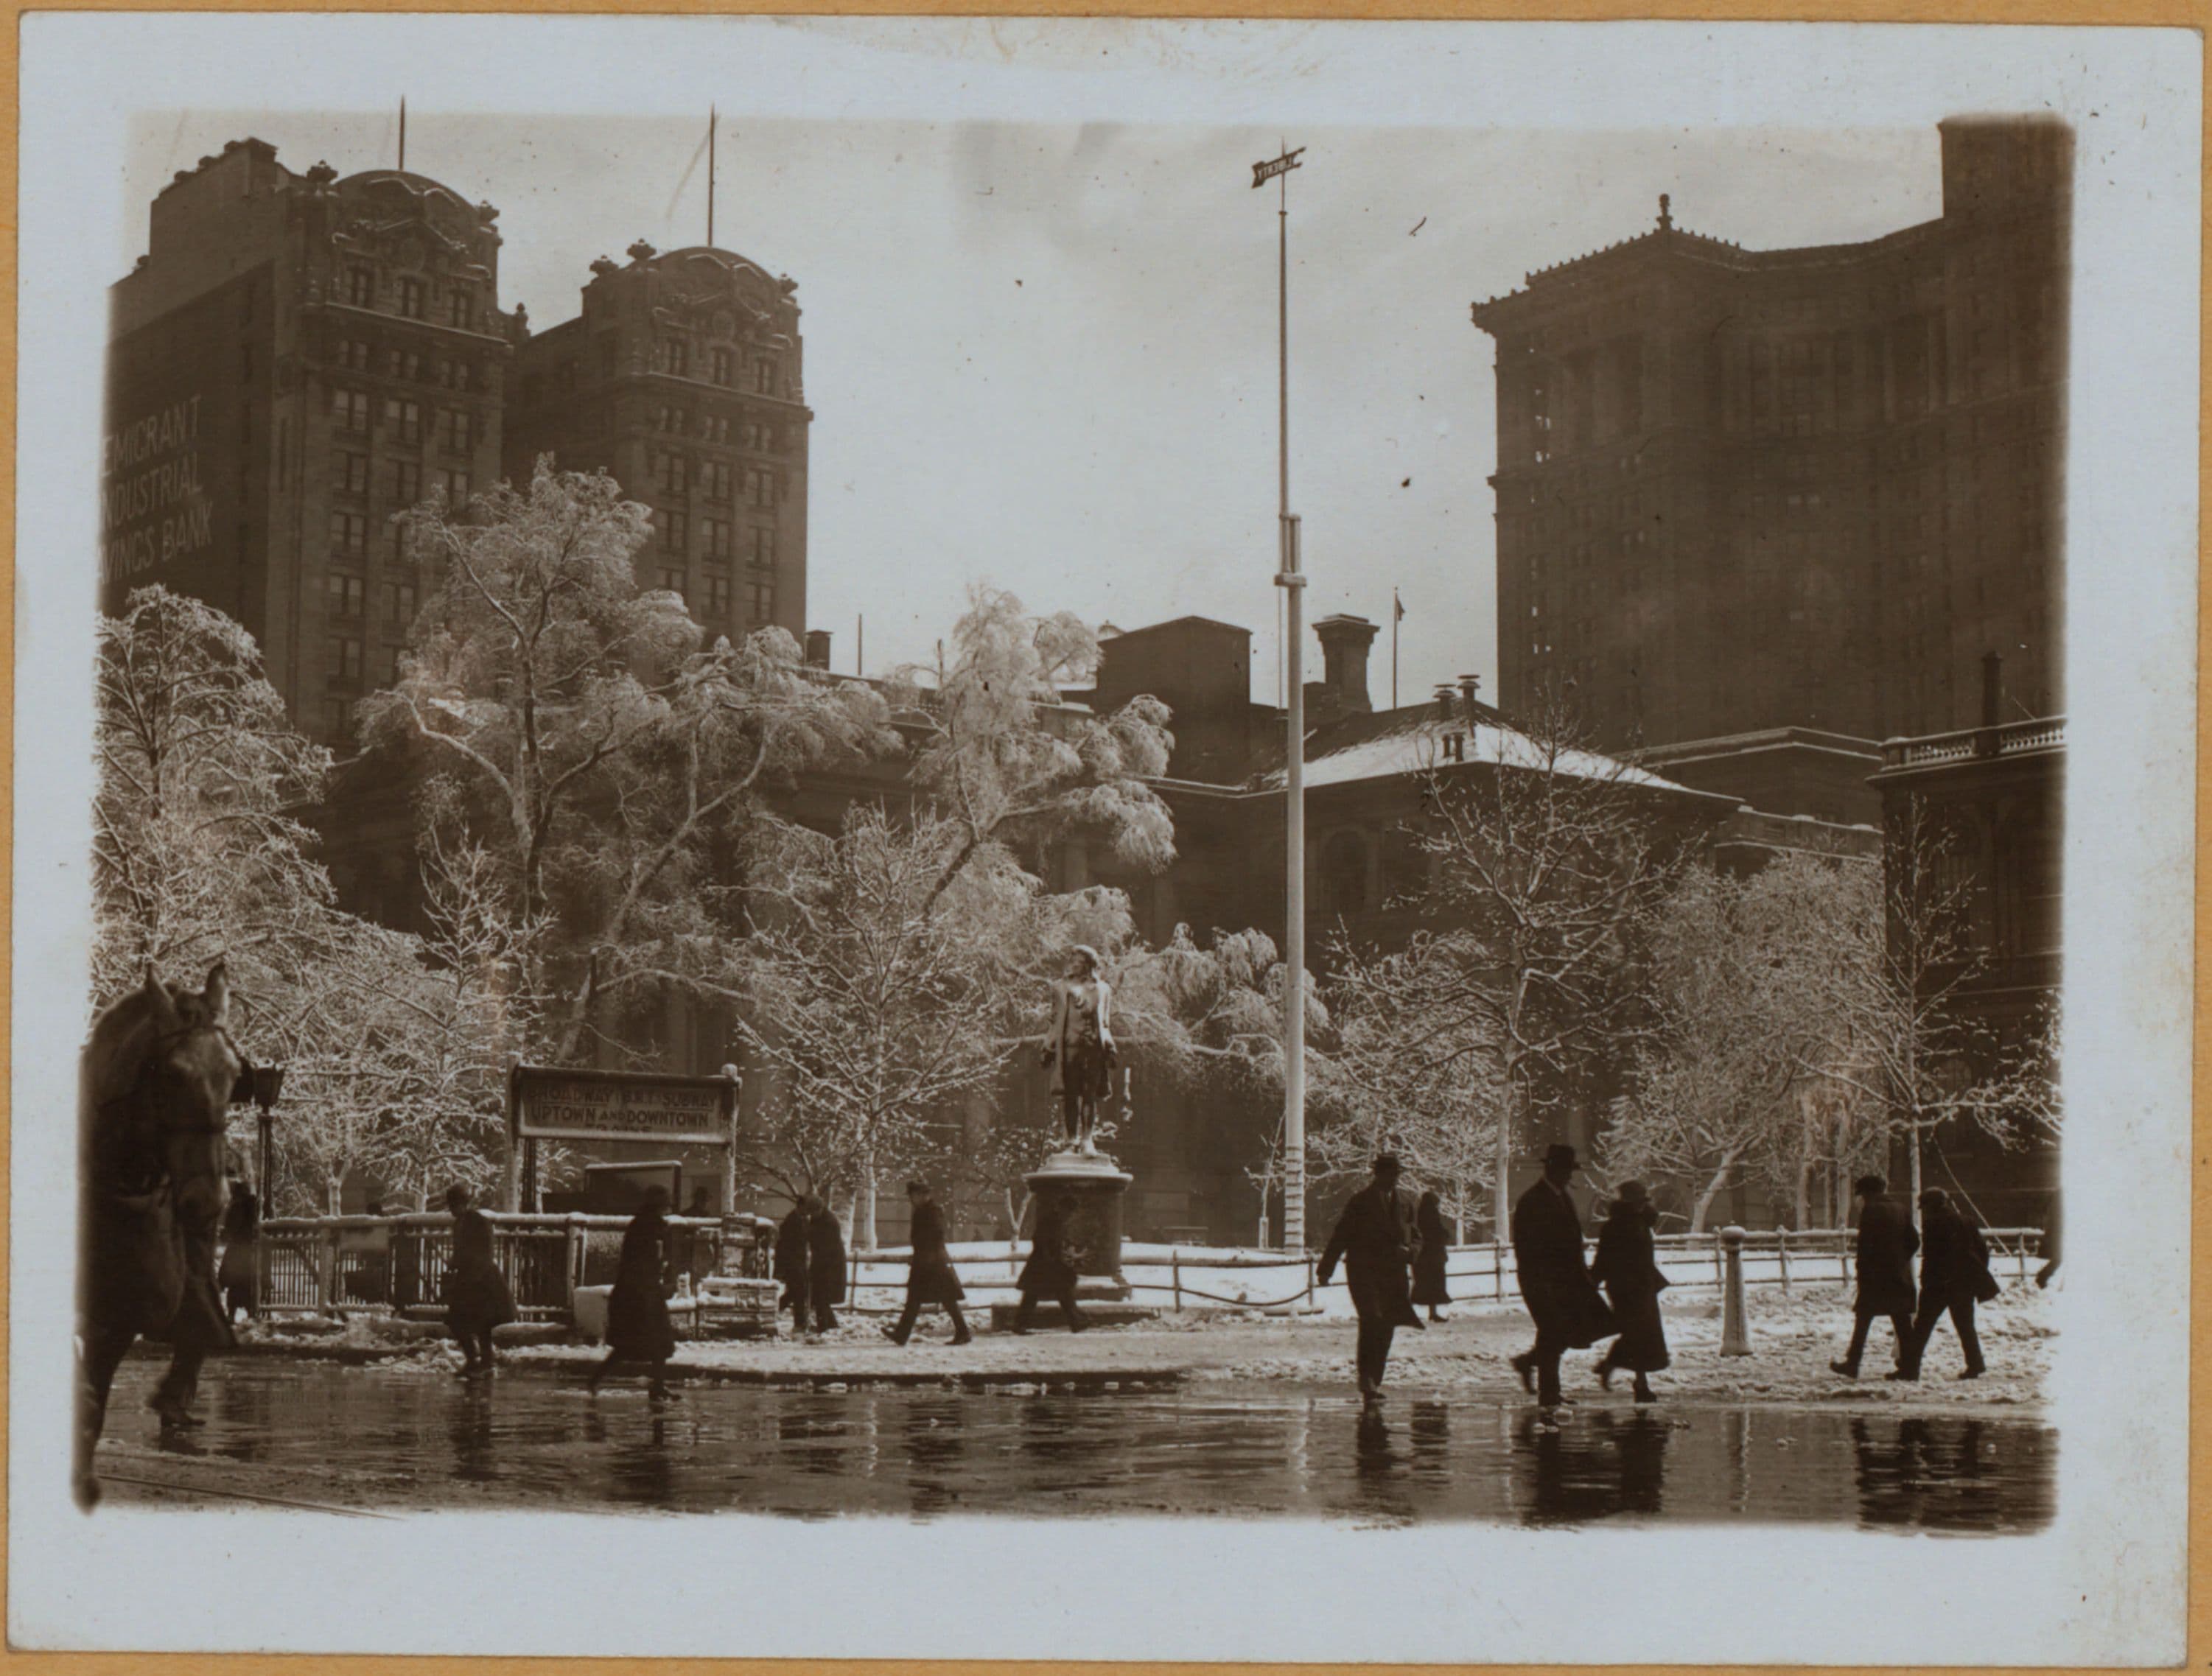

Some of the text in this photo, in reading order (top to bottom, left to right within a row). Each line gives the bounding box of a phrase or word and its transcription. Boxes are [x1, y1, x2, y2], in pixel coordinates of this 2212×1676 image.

[161, 501, 213, 562] BANK
[528, 1087, 611, 1103] BROADWAY
[663, 1093, 715, 1107] SUBWAY
[531, 1105, 708, 1126] UPTOWN AND DOWNTOWN
